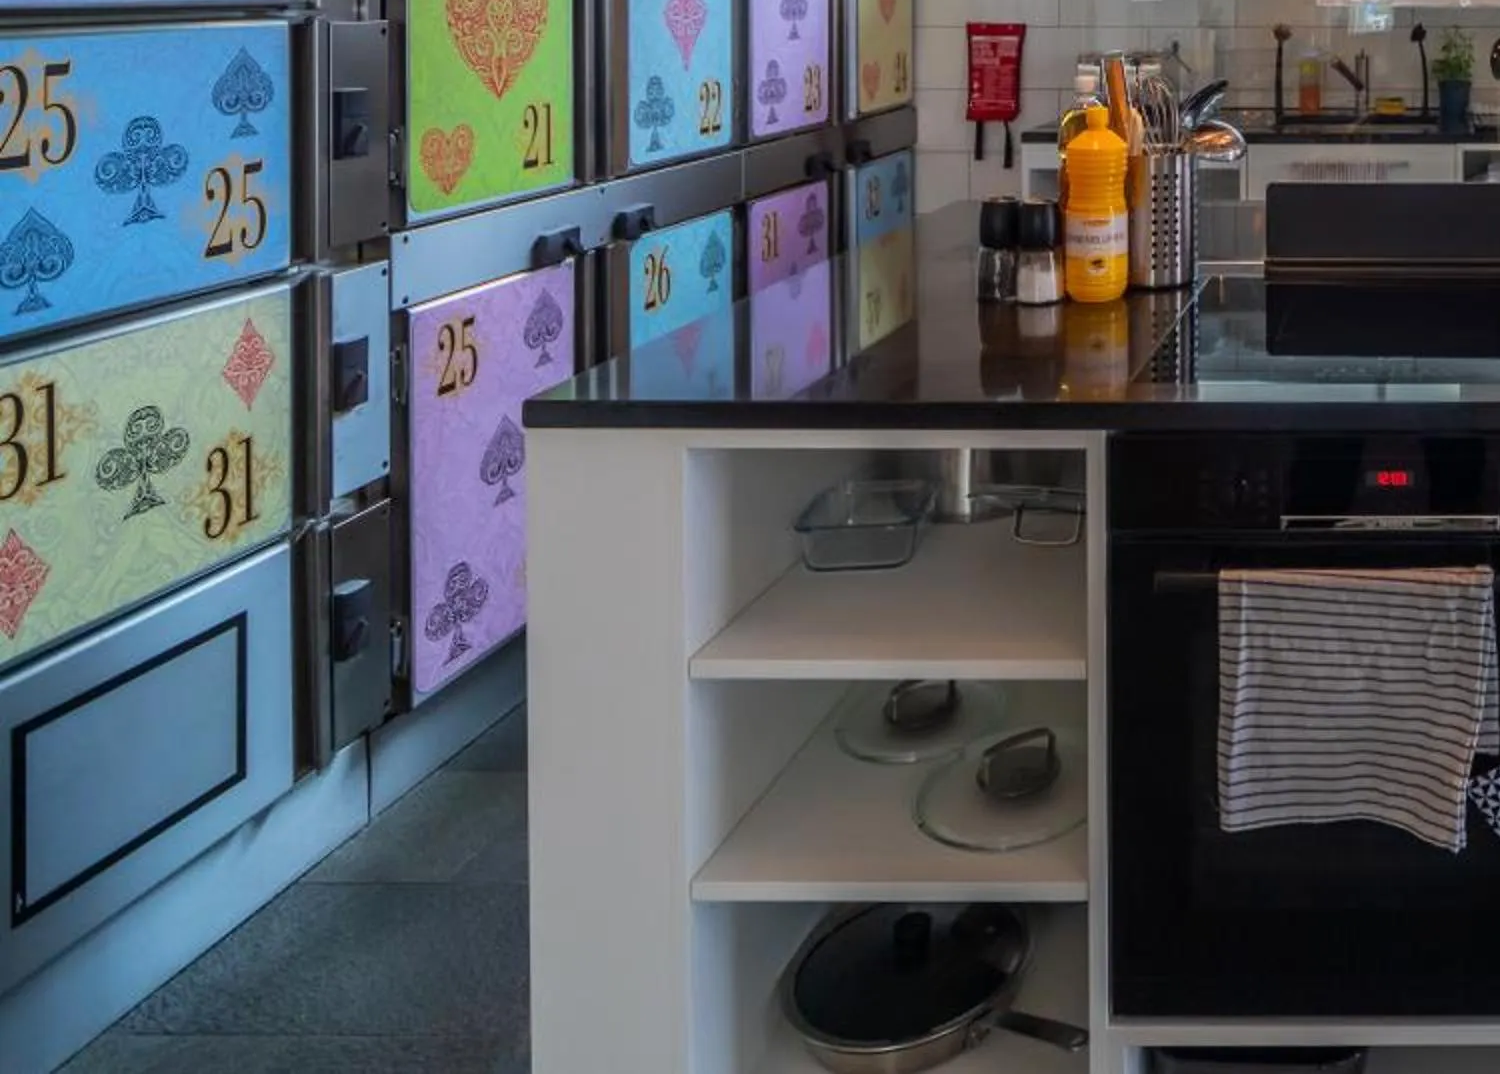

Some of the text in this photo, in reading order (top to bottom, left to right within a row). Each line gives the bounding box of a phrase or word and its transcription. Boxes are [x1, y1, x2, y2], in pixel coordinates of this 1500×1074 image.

[0, 60, 76, 170] 25
[699, 81, 722, 135] 22
[804, 65, 822, 111] 23
[523, 103, 556, 169] 21
[204, 158, 266, 258] 25
[762, 211, 779, 262] 31
[644, 246, 671, 311] 26
[437, 317, 477, 397] 25
[0, 382, 66, 501] 31
[203, 436, 260, 539] 31
